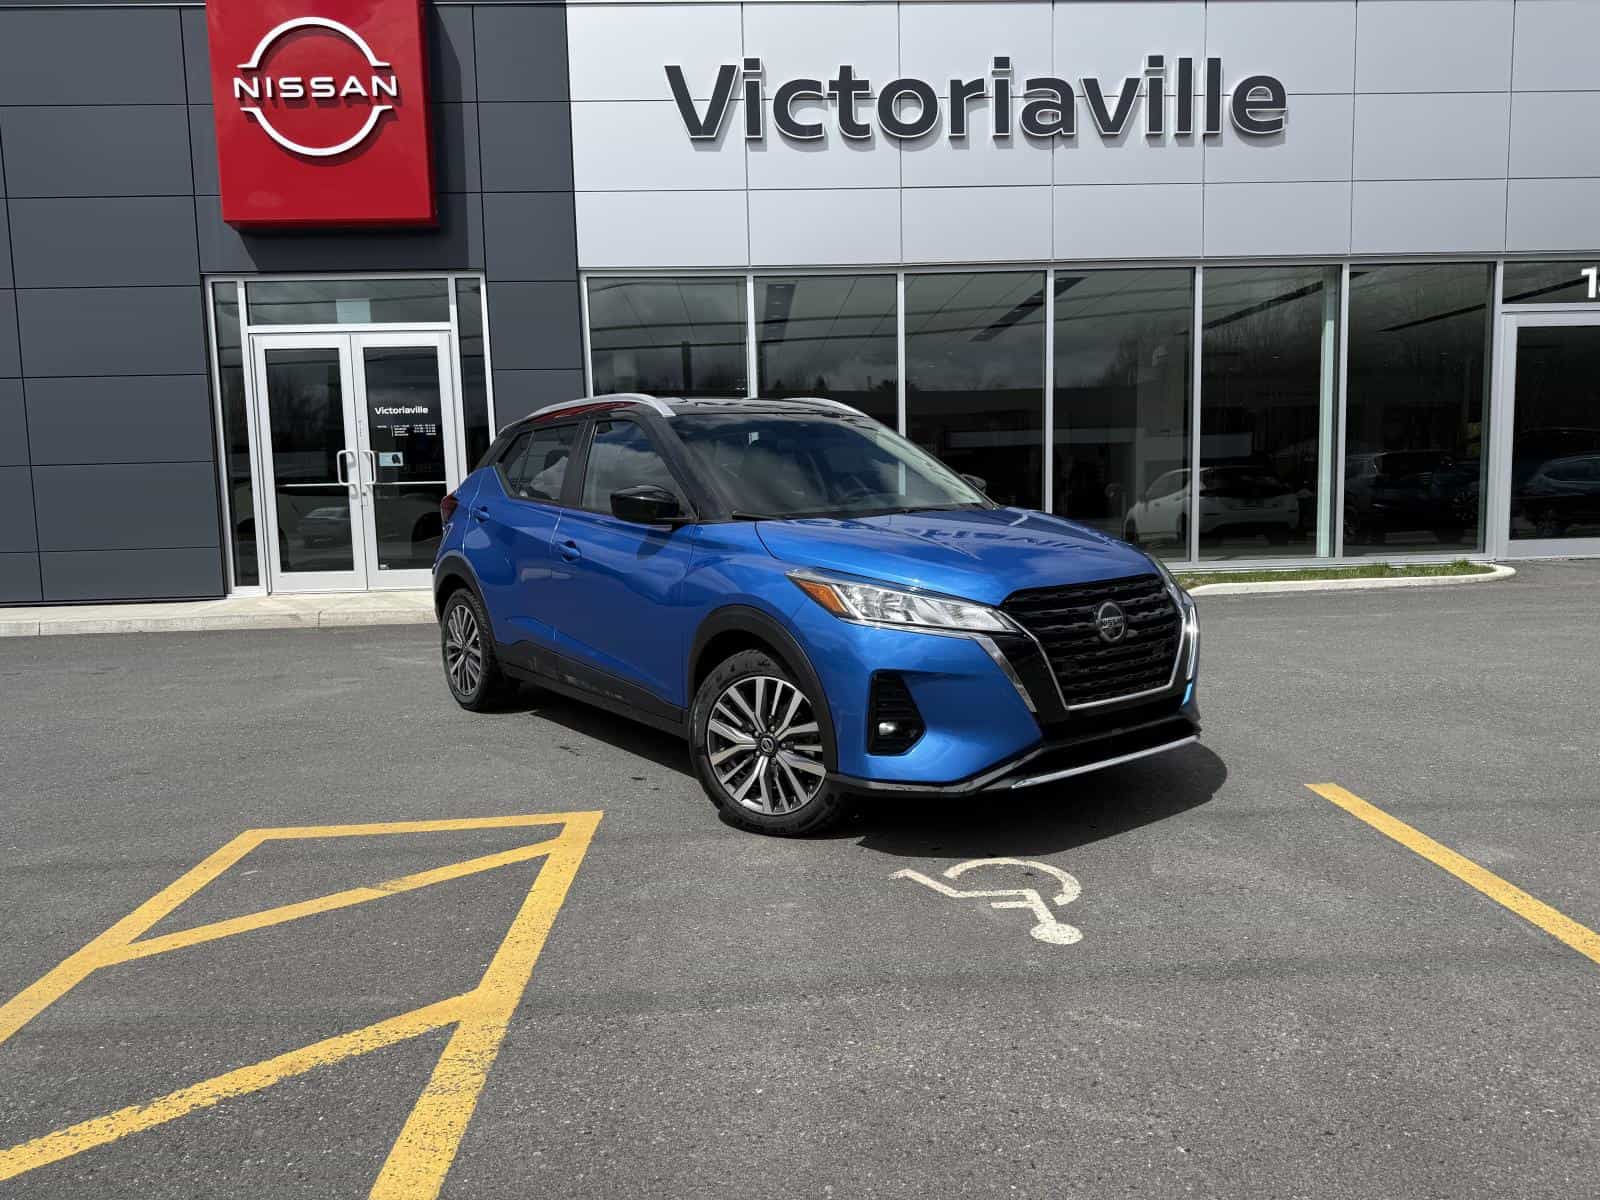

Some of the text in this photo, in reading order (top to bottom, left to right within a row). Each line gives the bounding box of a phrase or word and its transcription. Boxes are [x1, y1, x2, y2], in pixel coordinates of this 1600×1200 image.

[233, 76, 398, 98] NISSAN
[663, 55, 1287, 138] Victoriaville
[1581, 266, 1600, 298] 1
[374, 406, 429, 415] Victoriaville
